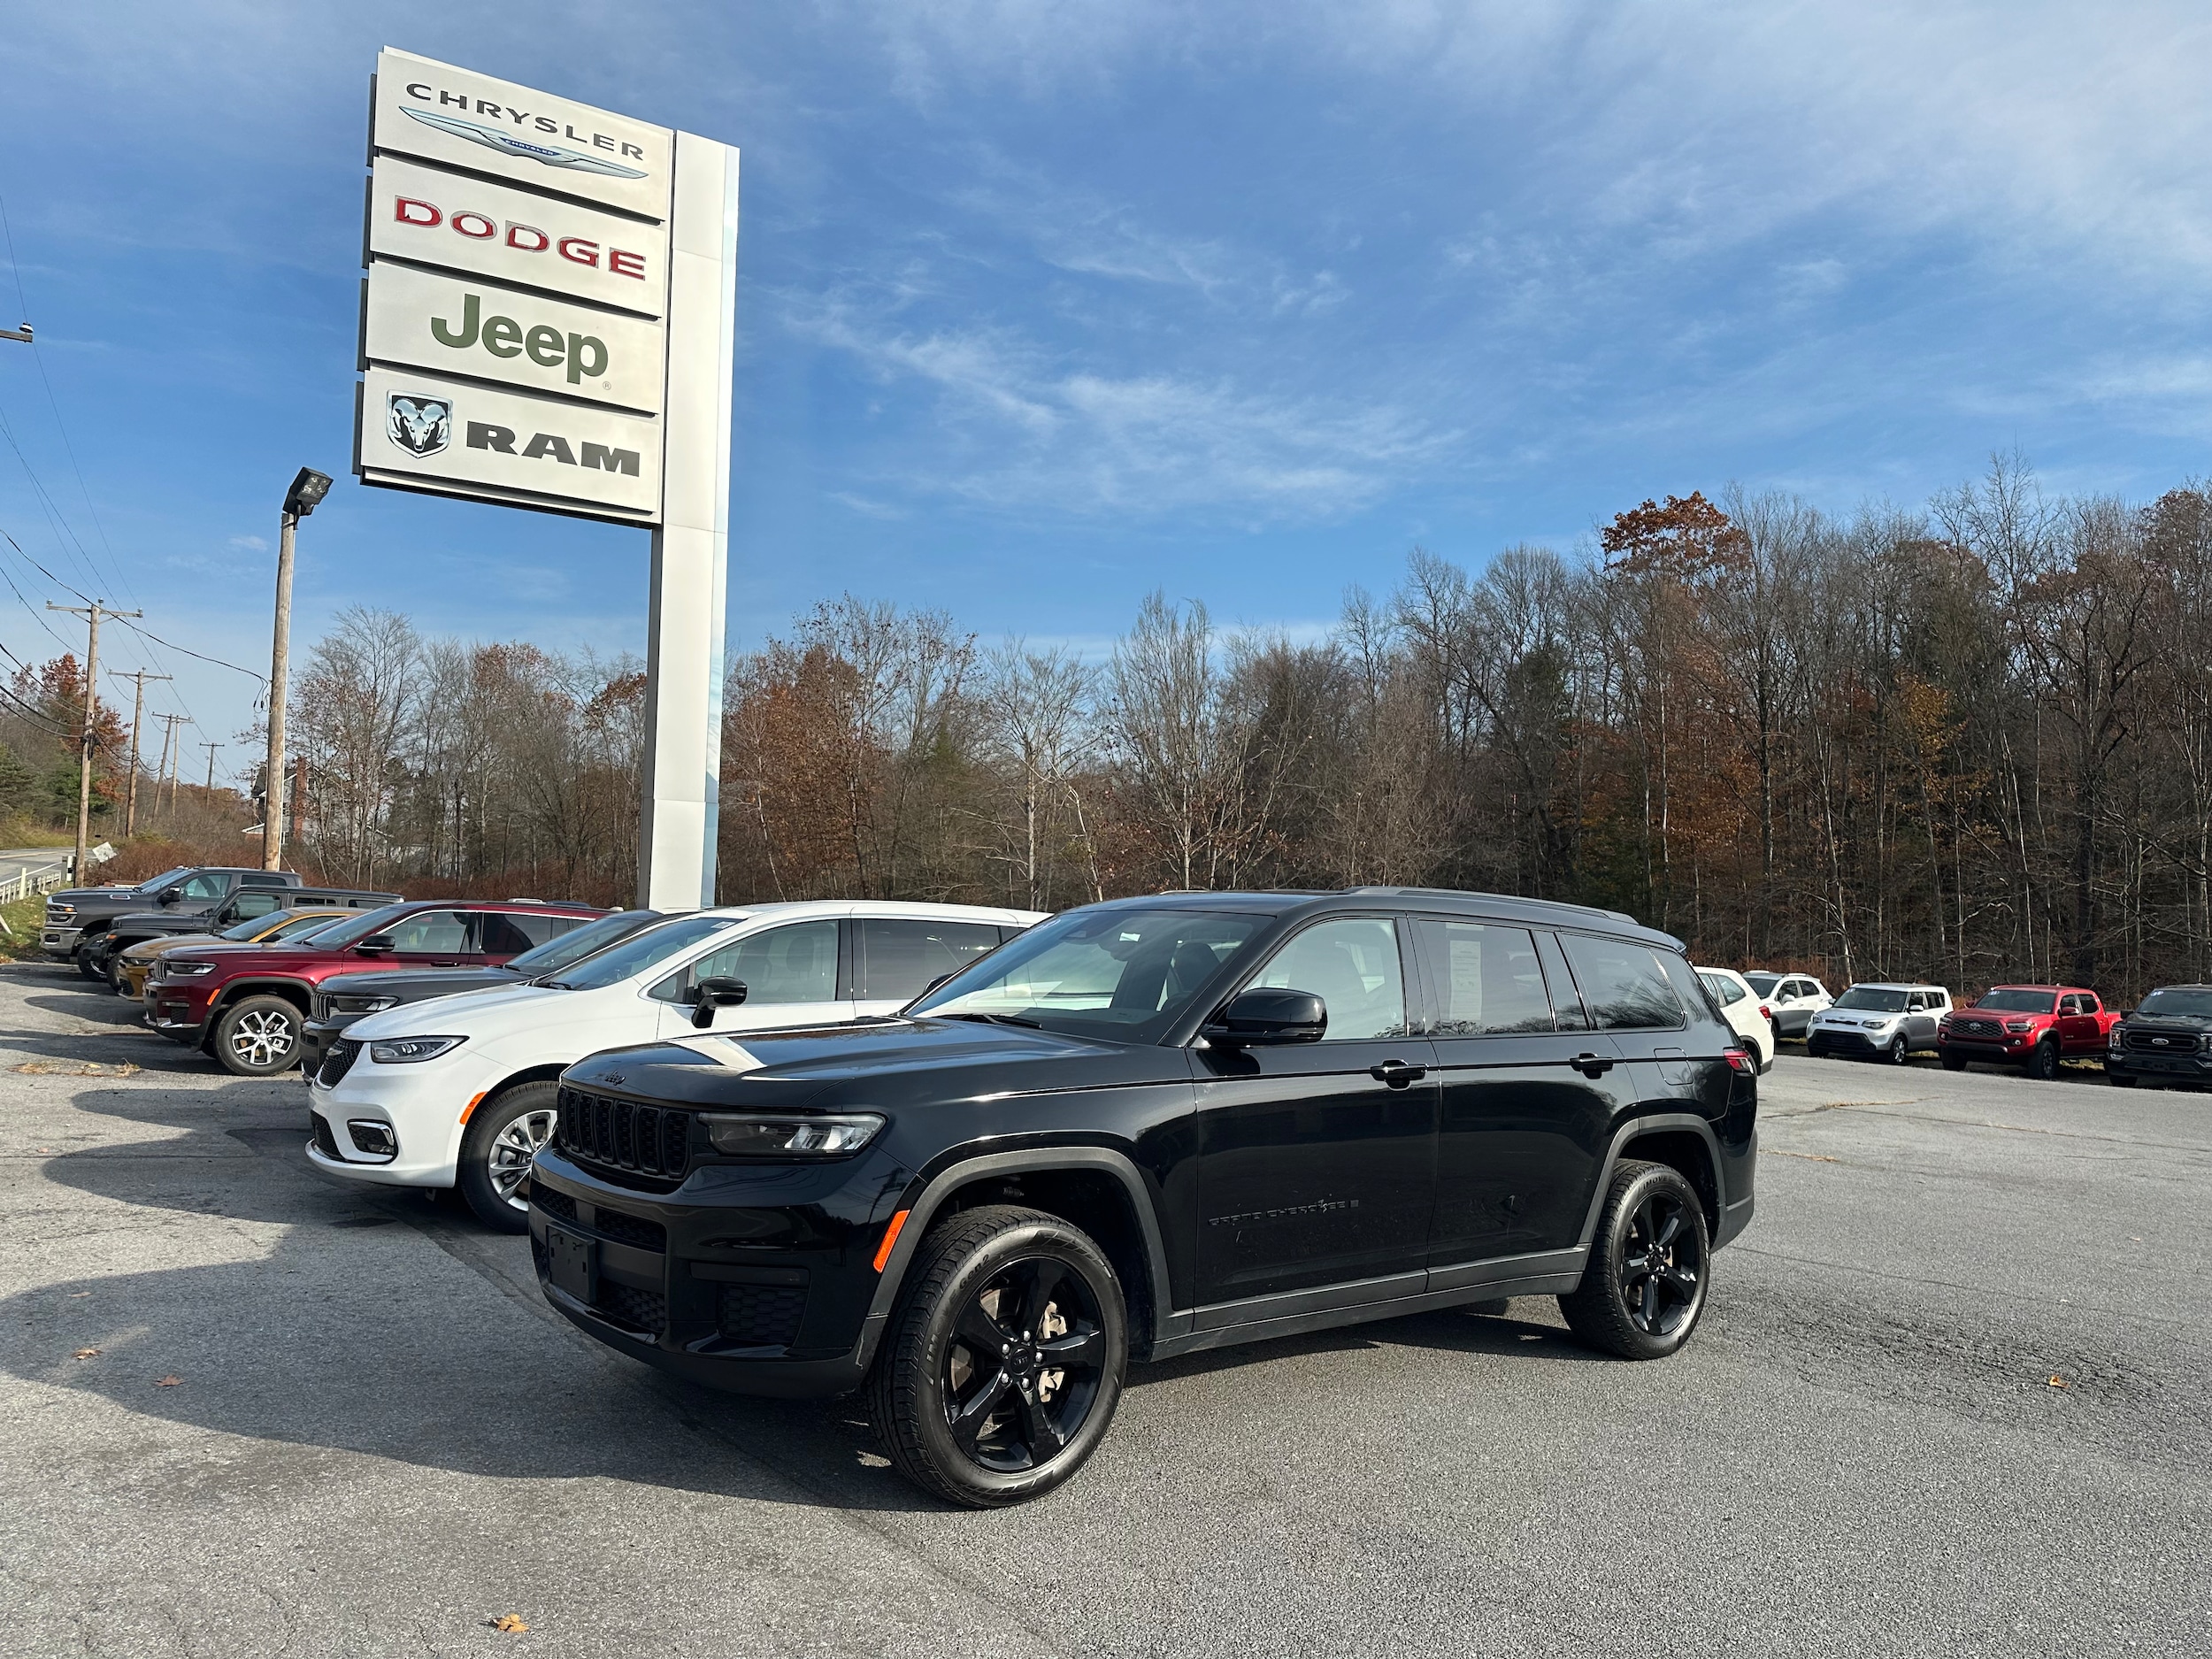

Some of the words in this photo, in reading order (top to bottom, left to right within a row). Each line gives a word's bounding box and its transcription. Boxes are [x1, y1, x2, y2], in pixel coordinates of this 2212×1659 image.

[406, 83, 644, 161] CHRYSLER
[394, 196, 647, 280] DODGE
[431, 294, 609, 384] Jeep
[466, 421, 641, 478] RAM
